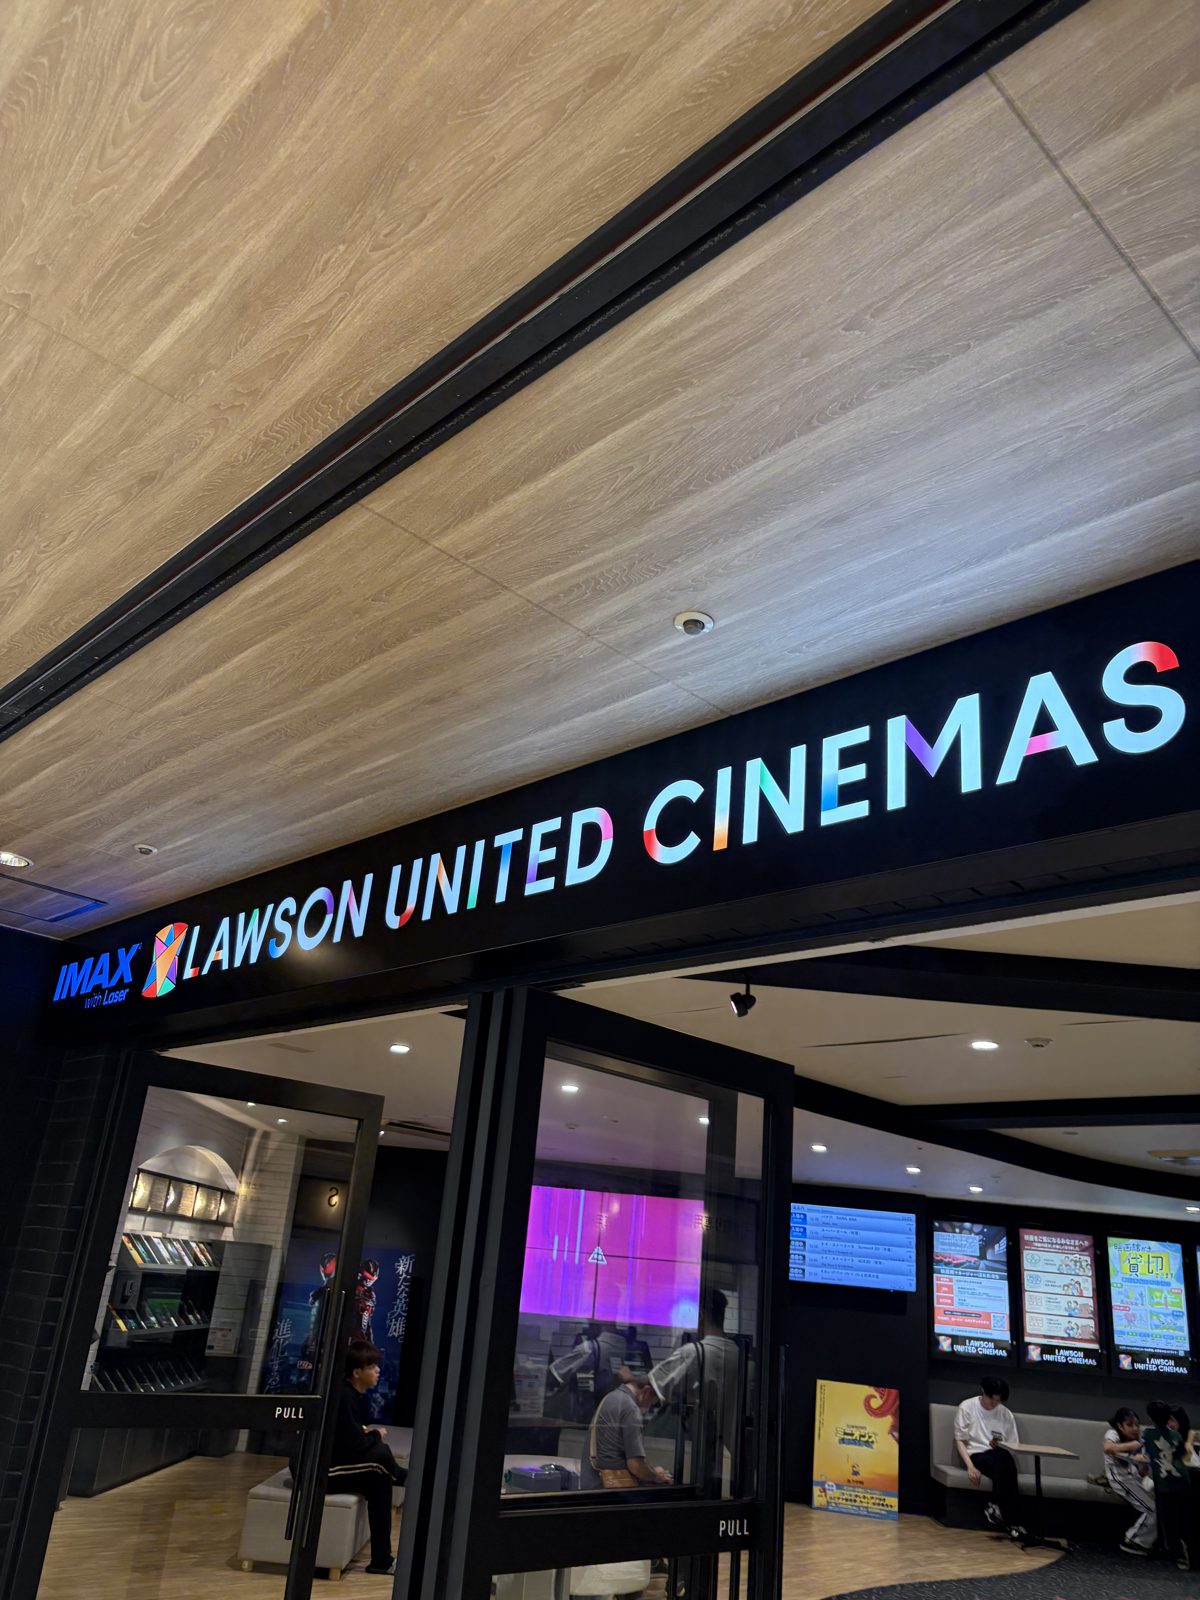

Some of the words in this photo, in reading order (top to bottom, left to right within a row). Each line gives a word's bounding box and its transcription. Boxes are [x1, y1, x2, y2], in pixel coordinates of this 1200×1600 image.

[183, 873, 374, 980] LAWSON
[384, 807, 614, 930] UNITED
[642, 641, 1187, 866] CINEMAS
[53, 943, 139, 1002] IMAX
[84, 992, 102, 1009] with
[102, 988, 129, 1006] Laser
[965, 1339, 995, 1349] LAWSON
[953, 1344, 977, 1354] UNITED
[977, 1347, 1008, 1357] CINEMAS
[1055, 1348, 1084, 1358] LAWSON
[1042, 1354, 1067, 1363] UNITED
[1067, 1356, 1097, 1366] CINEMAS
[1146, 1357, 1175, 1366] LAWSON
[1133, 1362, 1157, 1371] UNITED
[1158, 1364, 1188, 1374] CINEMAS
[274, 1407, 305, 1419] PULL
[719, 1519, 749, 1537] PULL
